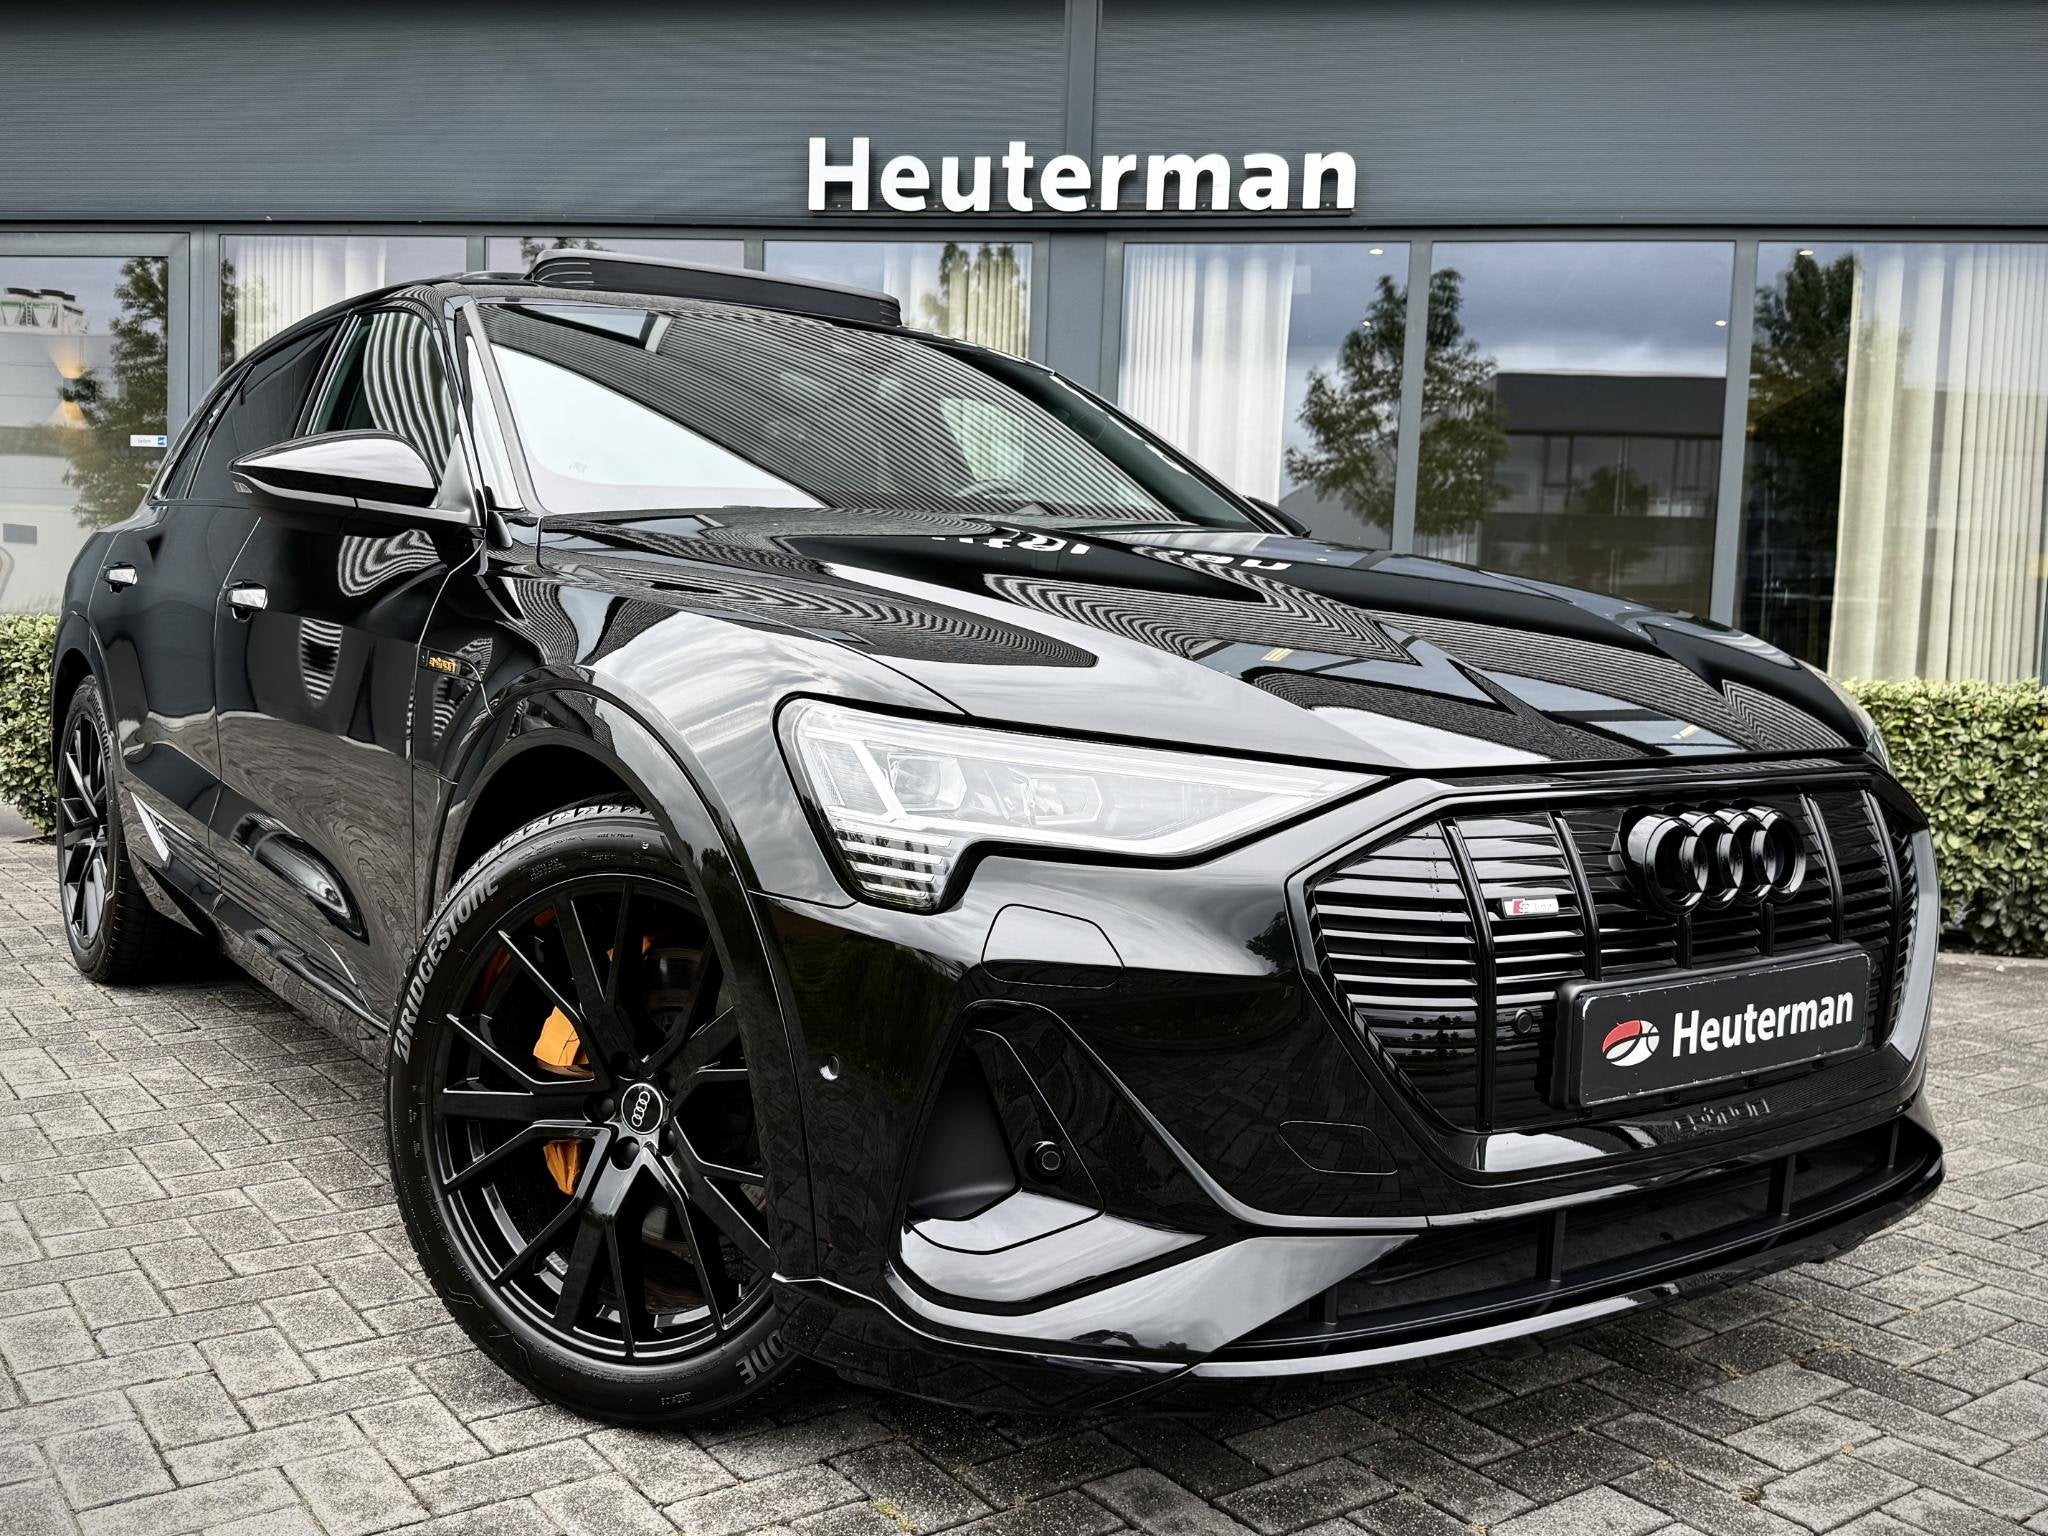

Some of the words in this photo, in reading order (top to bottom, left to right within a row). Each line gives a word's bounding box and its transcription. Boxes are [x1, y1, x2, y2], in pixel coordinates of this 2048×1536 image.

[808, 136, 1357, 212] Heuterman
[393, 866, 499, 1065] BRIDGESTONE
[1672, 991, 1854, 1058] Heuterman
